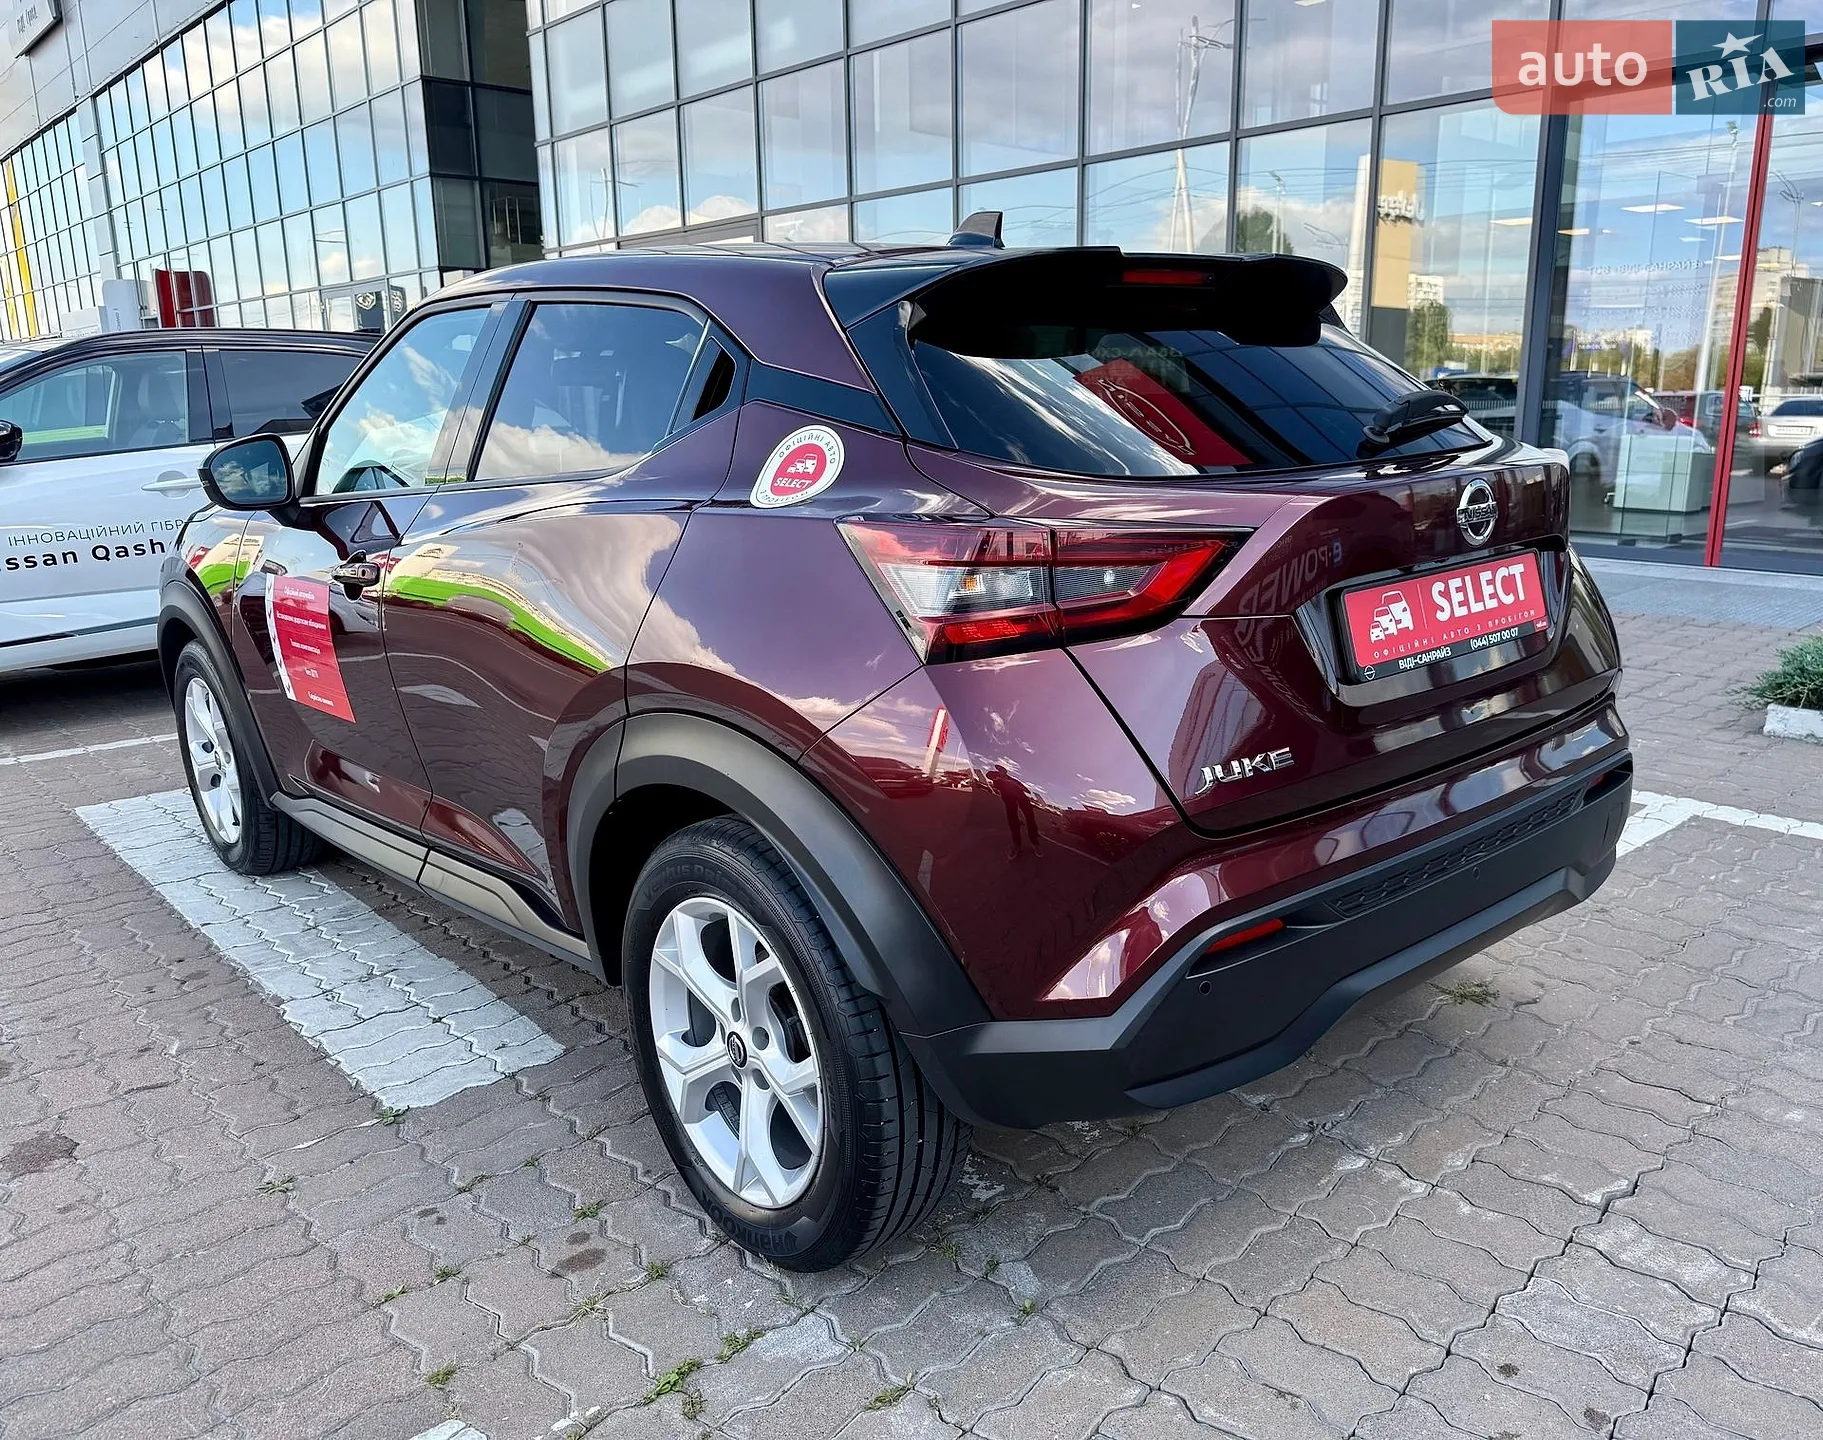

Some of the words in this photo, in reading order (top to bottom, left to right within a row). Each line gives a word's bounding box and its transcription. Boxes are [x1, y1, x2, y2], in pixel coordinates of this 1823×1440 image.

[773, 477, 813, 489] SELECT
[8, 521, 145, 547] ІННОВАЦІЙНИЙ
[91, 538, 166, 562] Qash
[1430, 563, 1525, 622] SELECT
[1373, 638, 1435, 659] ОФІЦІЙНІ
[1442, 627, 1470, 641] АВТО
[1398, 646, 1452, 670] ВІДІ-САНРАЙЗ
[1470, 635, 1489, 650] (044)
[1489, 632, 1500, 644] 507
[1500, 630, 1509, 641] 00
[1509, 627, 1519, 639] 07
[1194, 747, 1294, 796] JUKE
